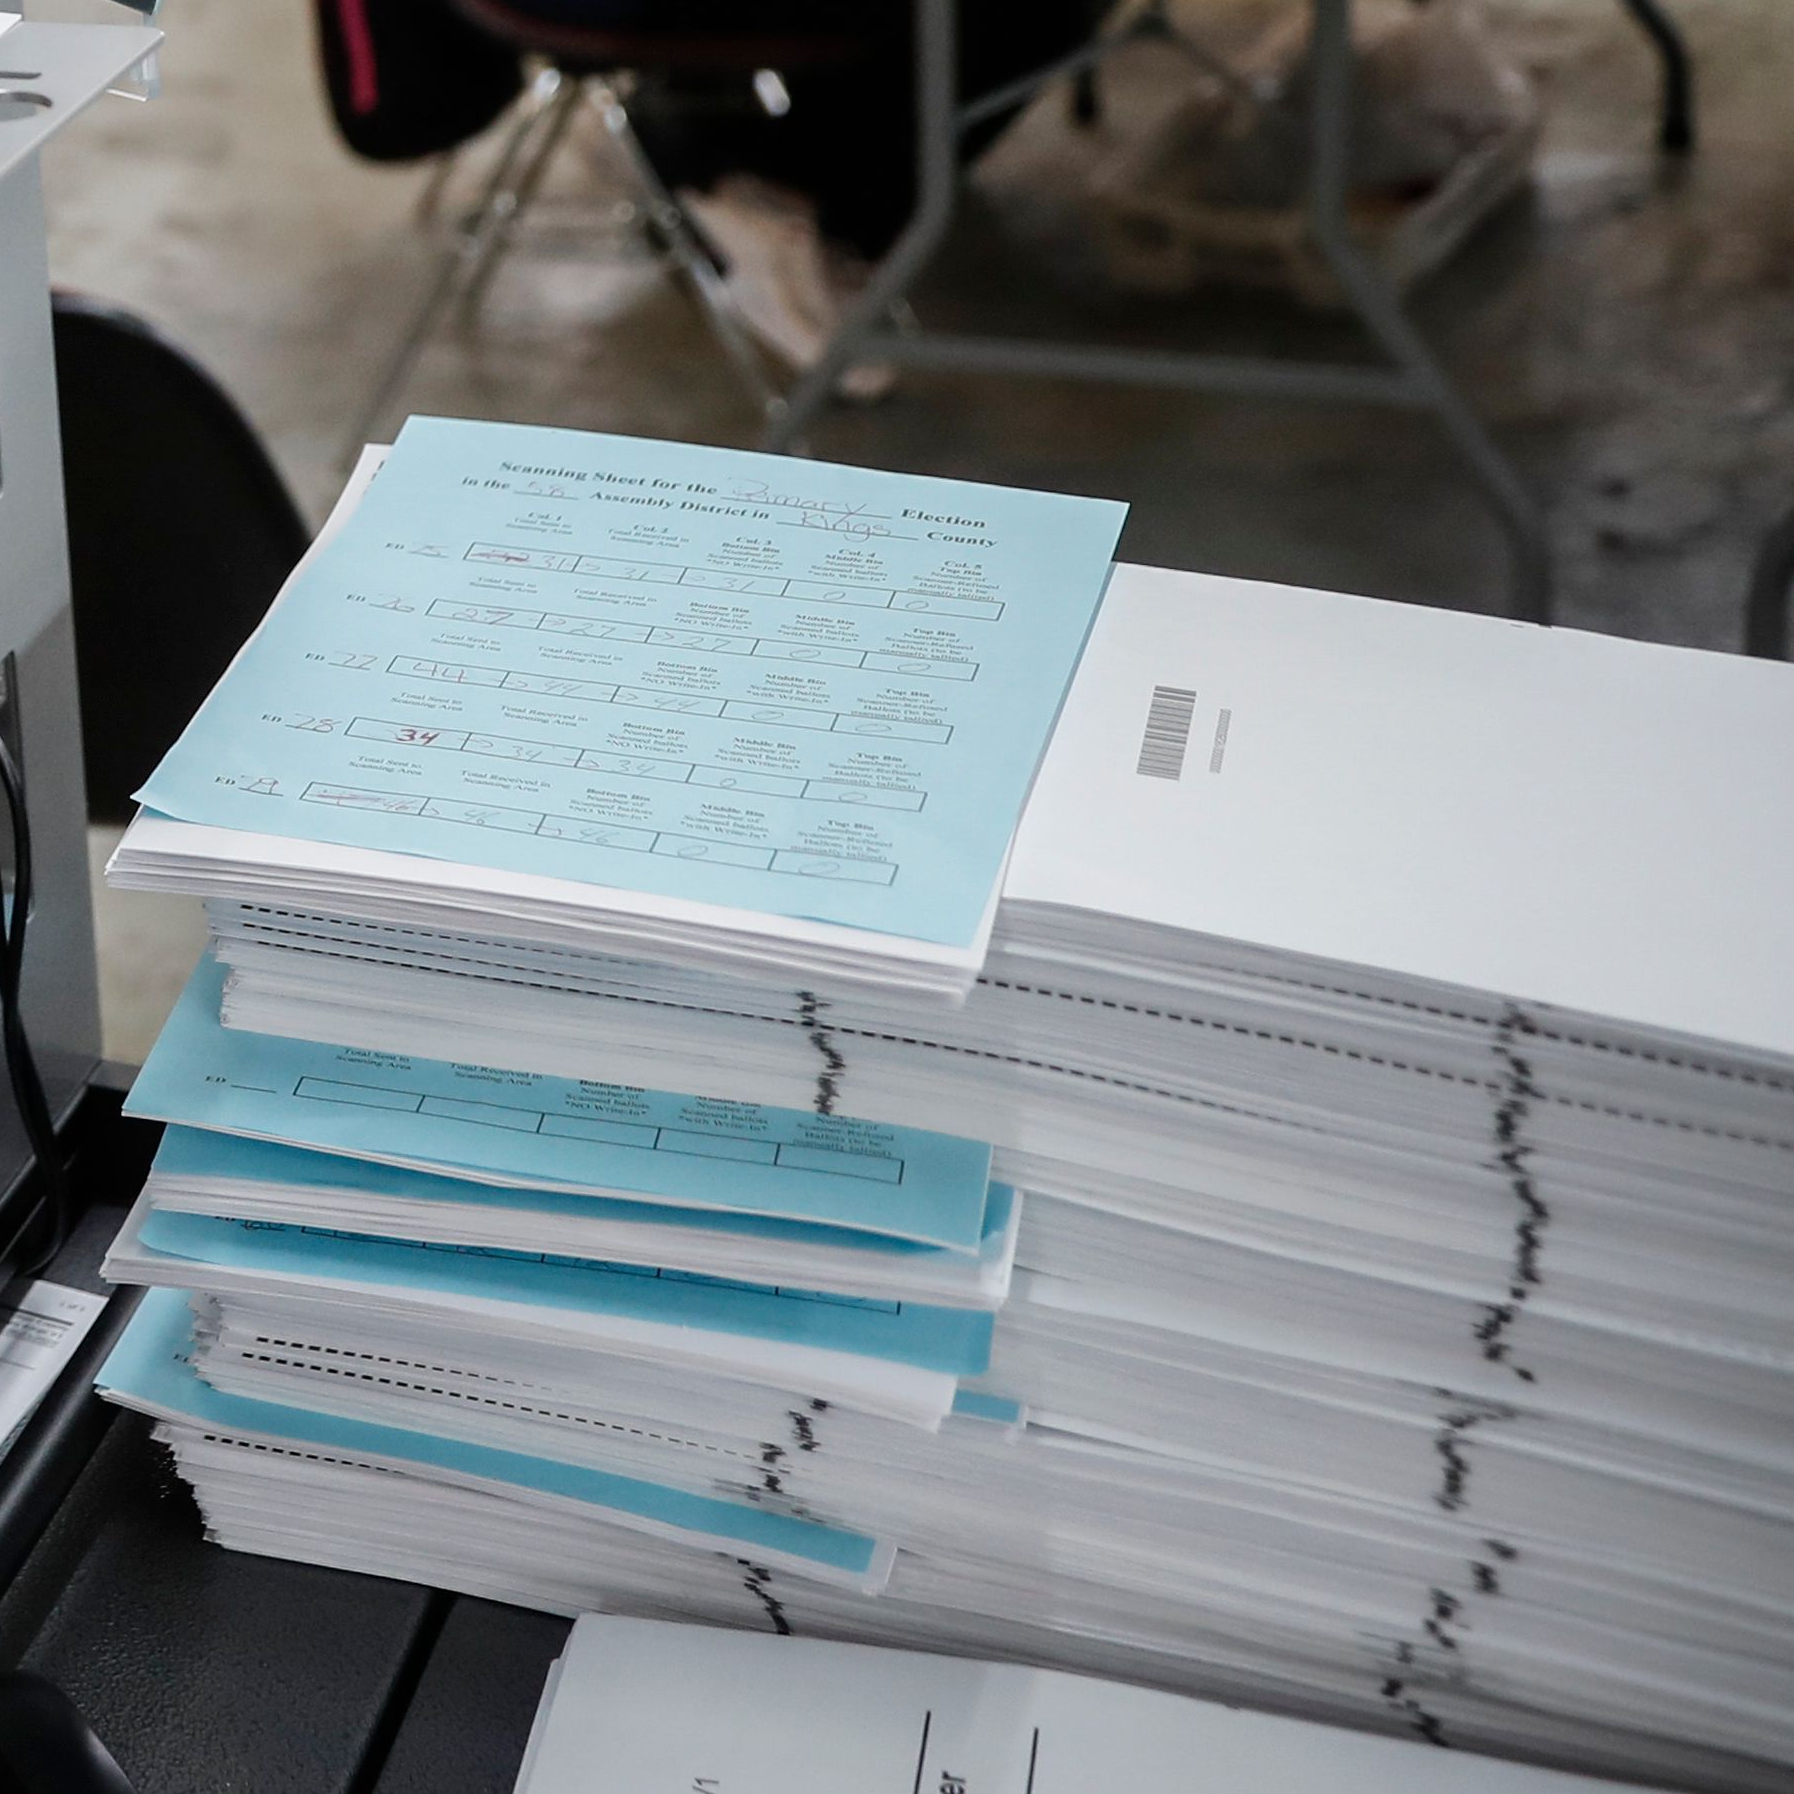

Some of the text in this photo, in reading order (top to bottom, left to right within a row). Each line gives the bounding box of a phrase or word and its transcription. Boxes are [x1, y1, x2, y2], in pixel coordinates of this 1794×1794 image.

[462, 477, 478, 487] in
[484, 480, 510, 491] the
[589, 491, 674, 511] Assembly
[680, 500, 746, 519] District
[750, 510, 769, 521] in
[927, 531, 1000, 548] County
[499, 461, 588, 482] Scanning
[593, 467, 645, 487] Sheet
[650, 477, 682, 492] for
[686, 482, 717, 496] the
[901, 508, 986, 529] Election
[393, 727, 441, 746] 34
